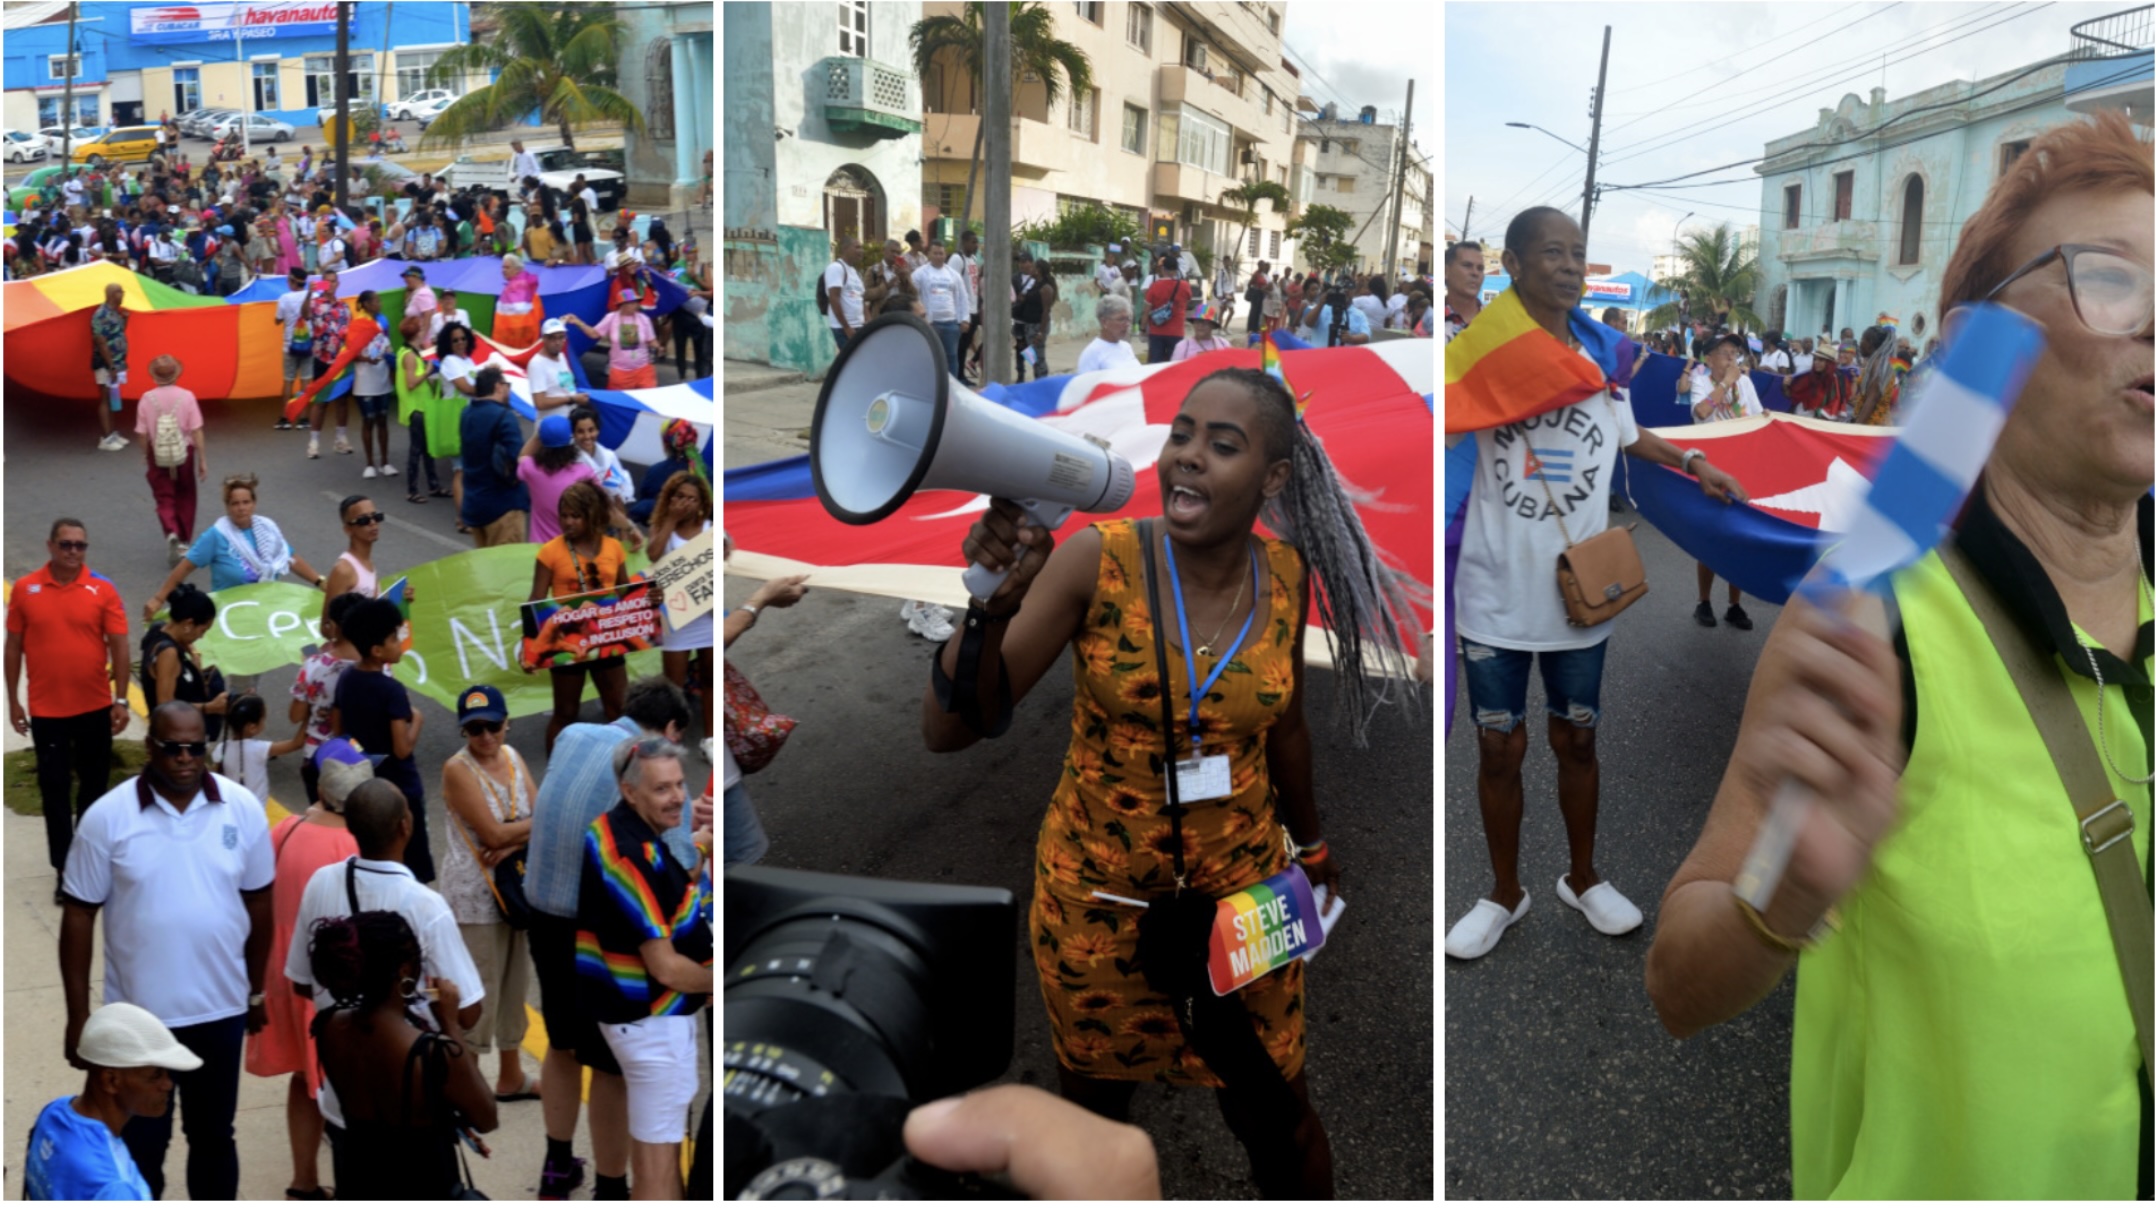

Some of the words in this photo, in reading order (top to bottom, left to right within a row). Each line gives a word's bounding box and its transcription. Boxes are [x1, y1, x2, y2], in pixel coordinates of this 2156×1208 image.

[244, 4, 339, 25] havanauto
[1494, 458, 1600, 521] CUBANA
[657, 548, 713, 589] ERECHOS
[690, 581, 713, 606] FA
[553, 607, 597, 624] HOGAR
[599, 606, 612, 616] es
[598, 609, 653, 629] RESPETO
[579, 639, 588, 647] e
[1233, 894, 1291, 942] STEVE
[1229, 918, 1307, 978] MADDEN
